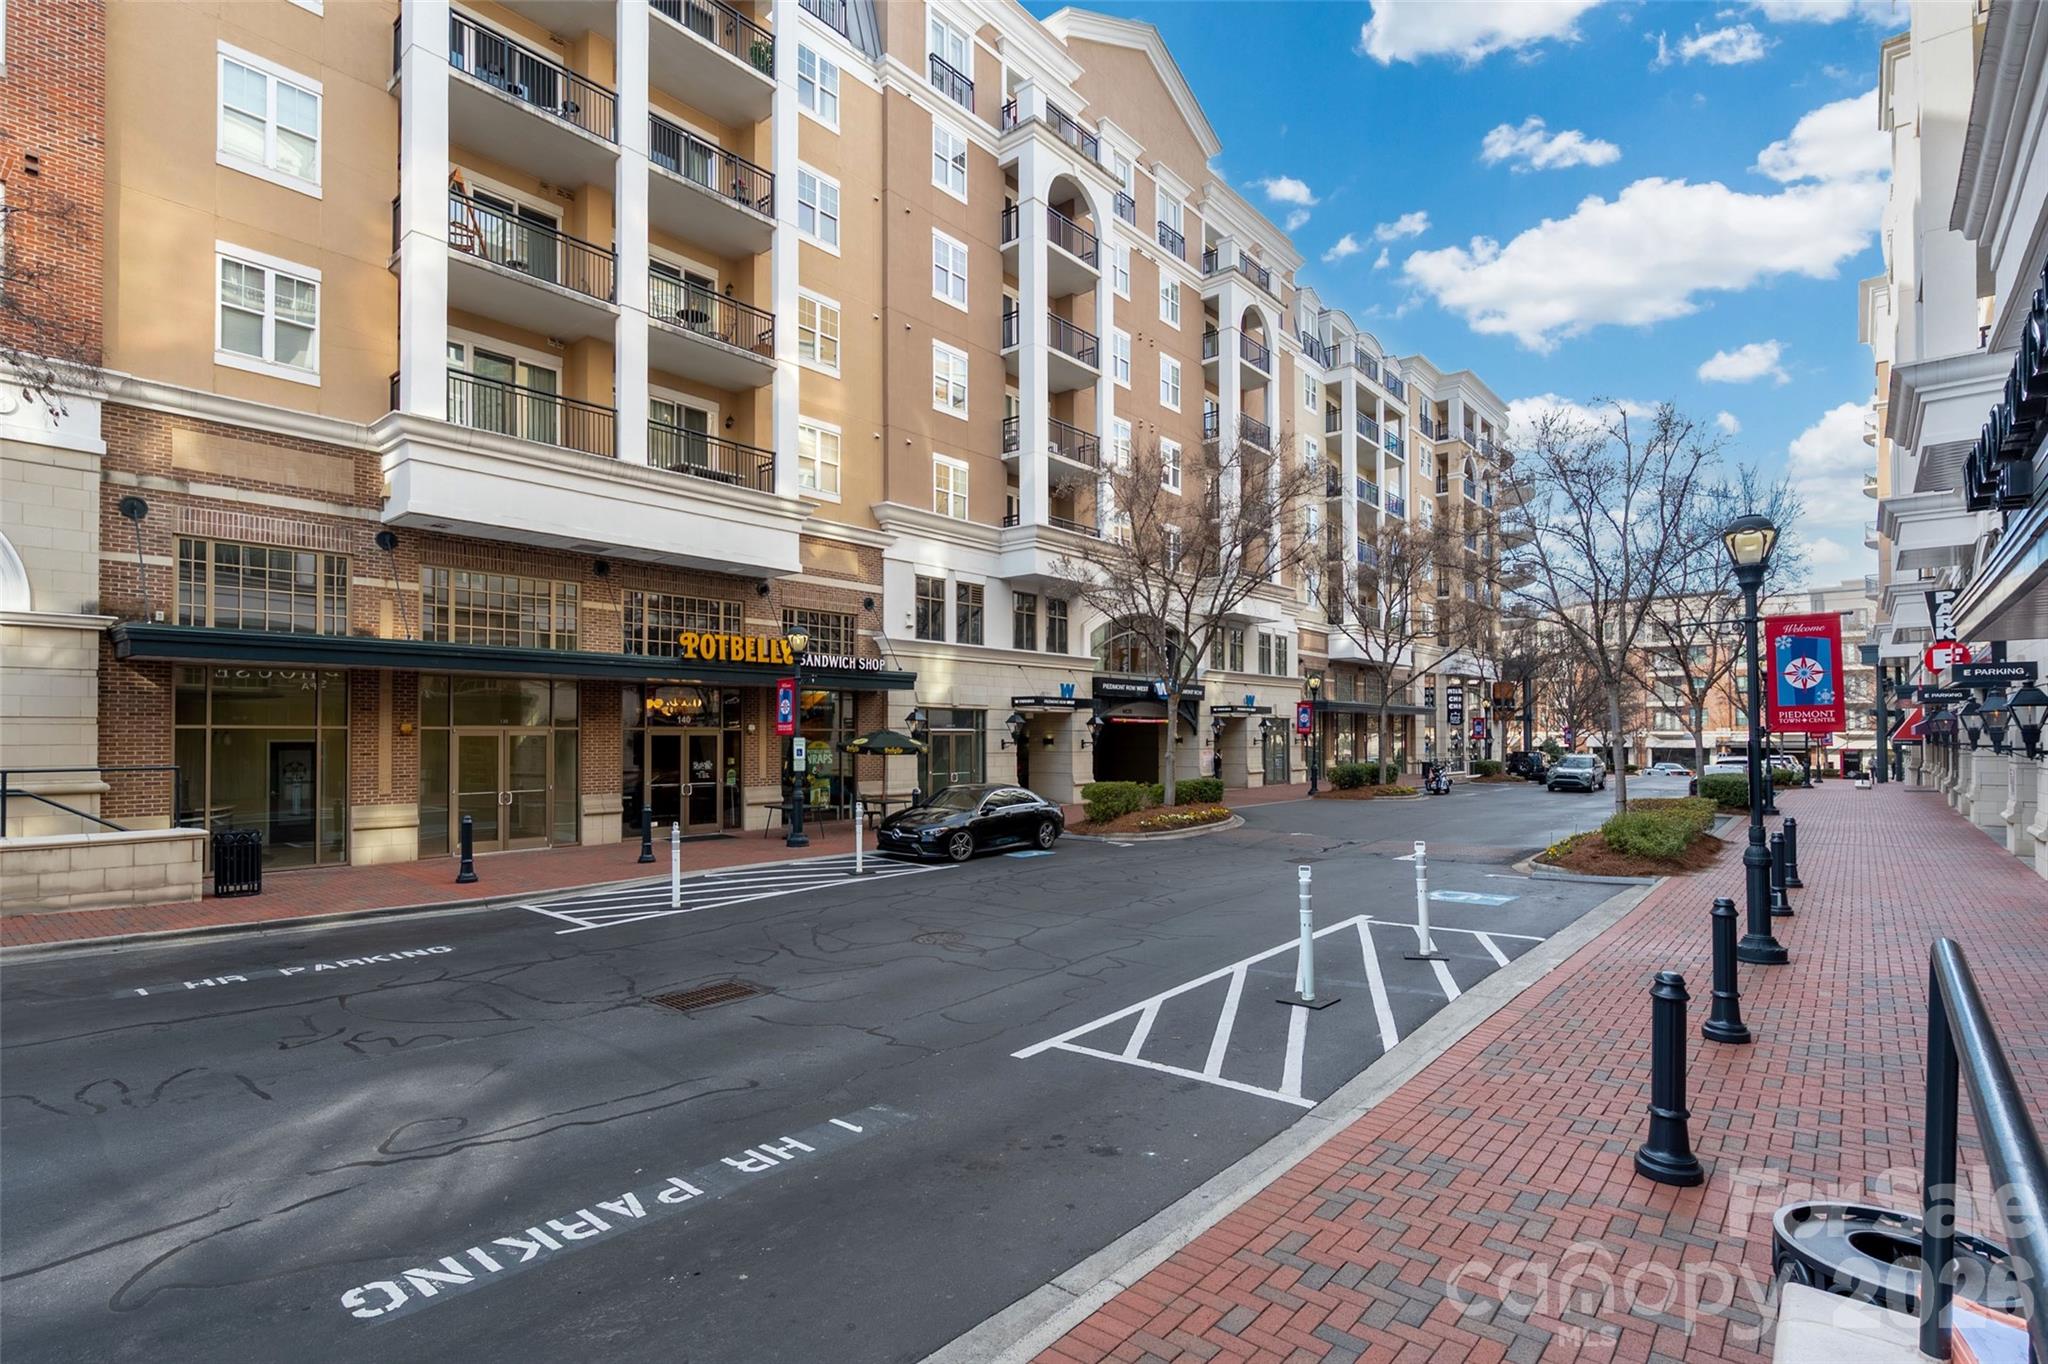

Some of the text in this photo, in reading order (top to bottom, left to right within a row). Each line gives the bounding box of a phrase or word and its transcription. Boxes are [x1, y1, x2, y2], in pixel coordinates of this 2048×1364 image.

[1935, 591, 1956, 640] PARK
[1782, 623, 1825, 634] Welcome
[679, 632, 794, 665] POTBELLY
[800, 654, 886, 671] SANDWICH SHOP
[1974, 667, 2025, 676] PARKING
[1060, 683, 1076, 698] W
[677, 716, 691, 724] 140
[1778, 710, 1836, 719] PIEDMONT
[133, 945, 454, 997] 1 HR PARKING
[341, 1117, 864, 1318] 1 HR PARKING
